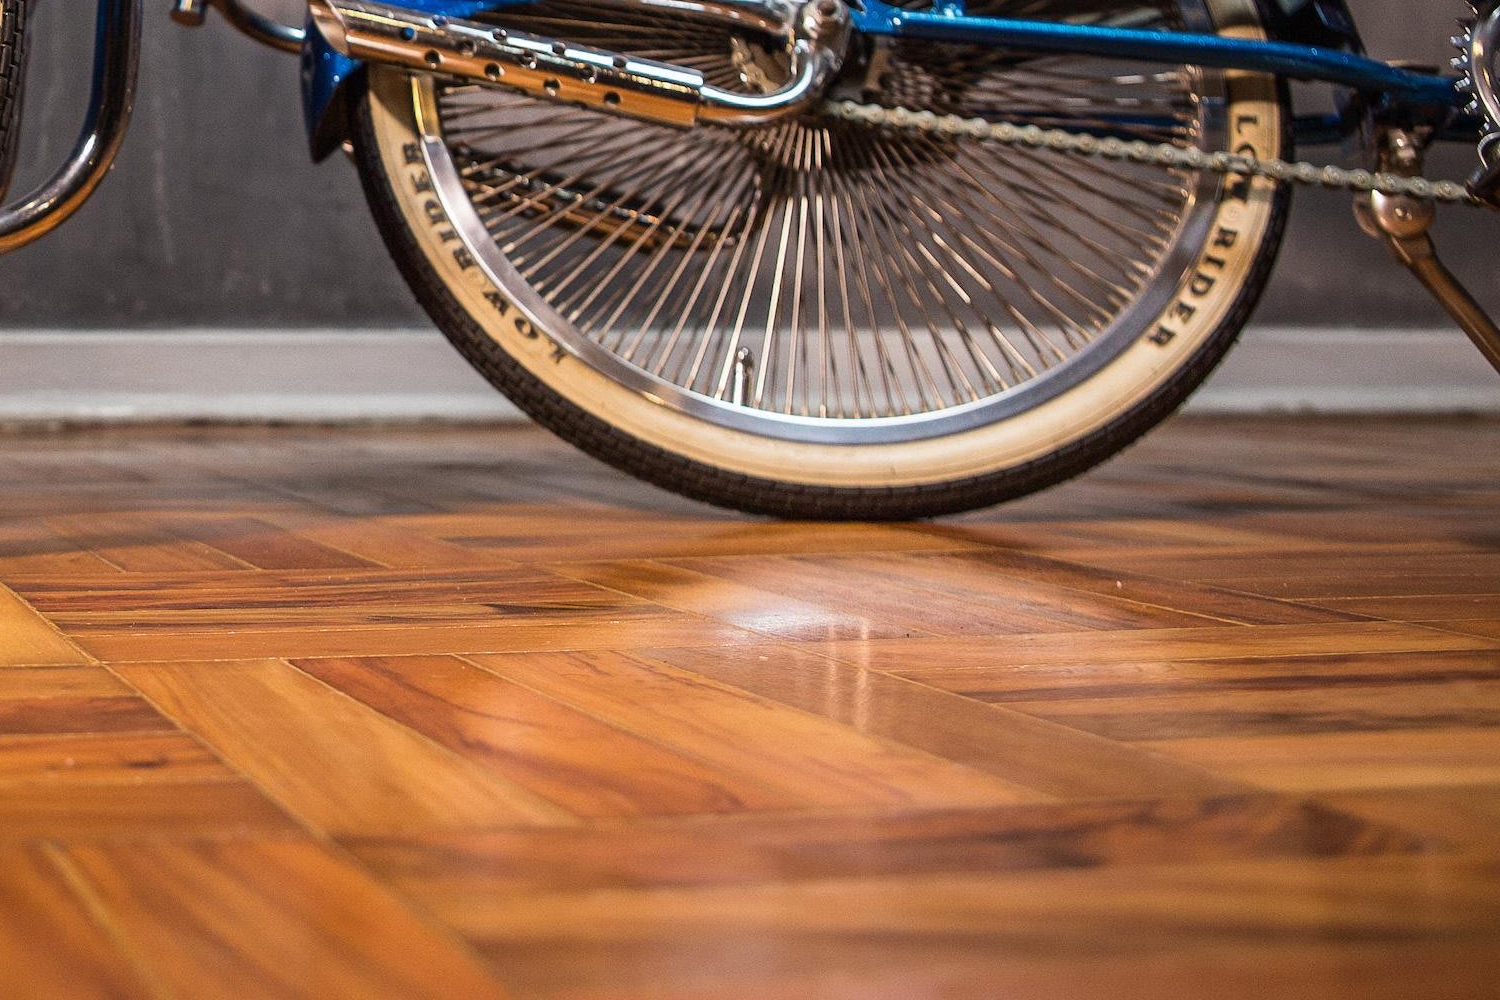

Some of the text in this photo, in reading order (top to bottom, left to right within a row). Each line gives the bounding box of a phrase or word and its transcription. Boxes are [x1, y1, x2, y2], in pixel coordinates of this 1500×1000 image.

[402, 142, 567, 364] LOW RIDER
[1148, 225, 1238, 347] RIDER
